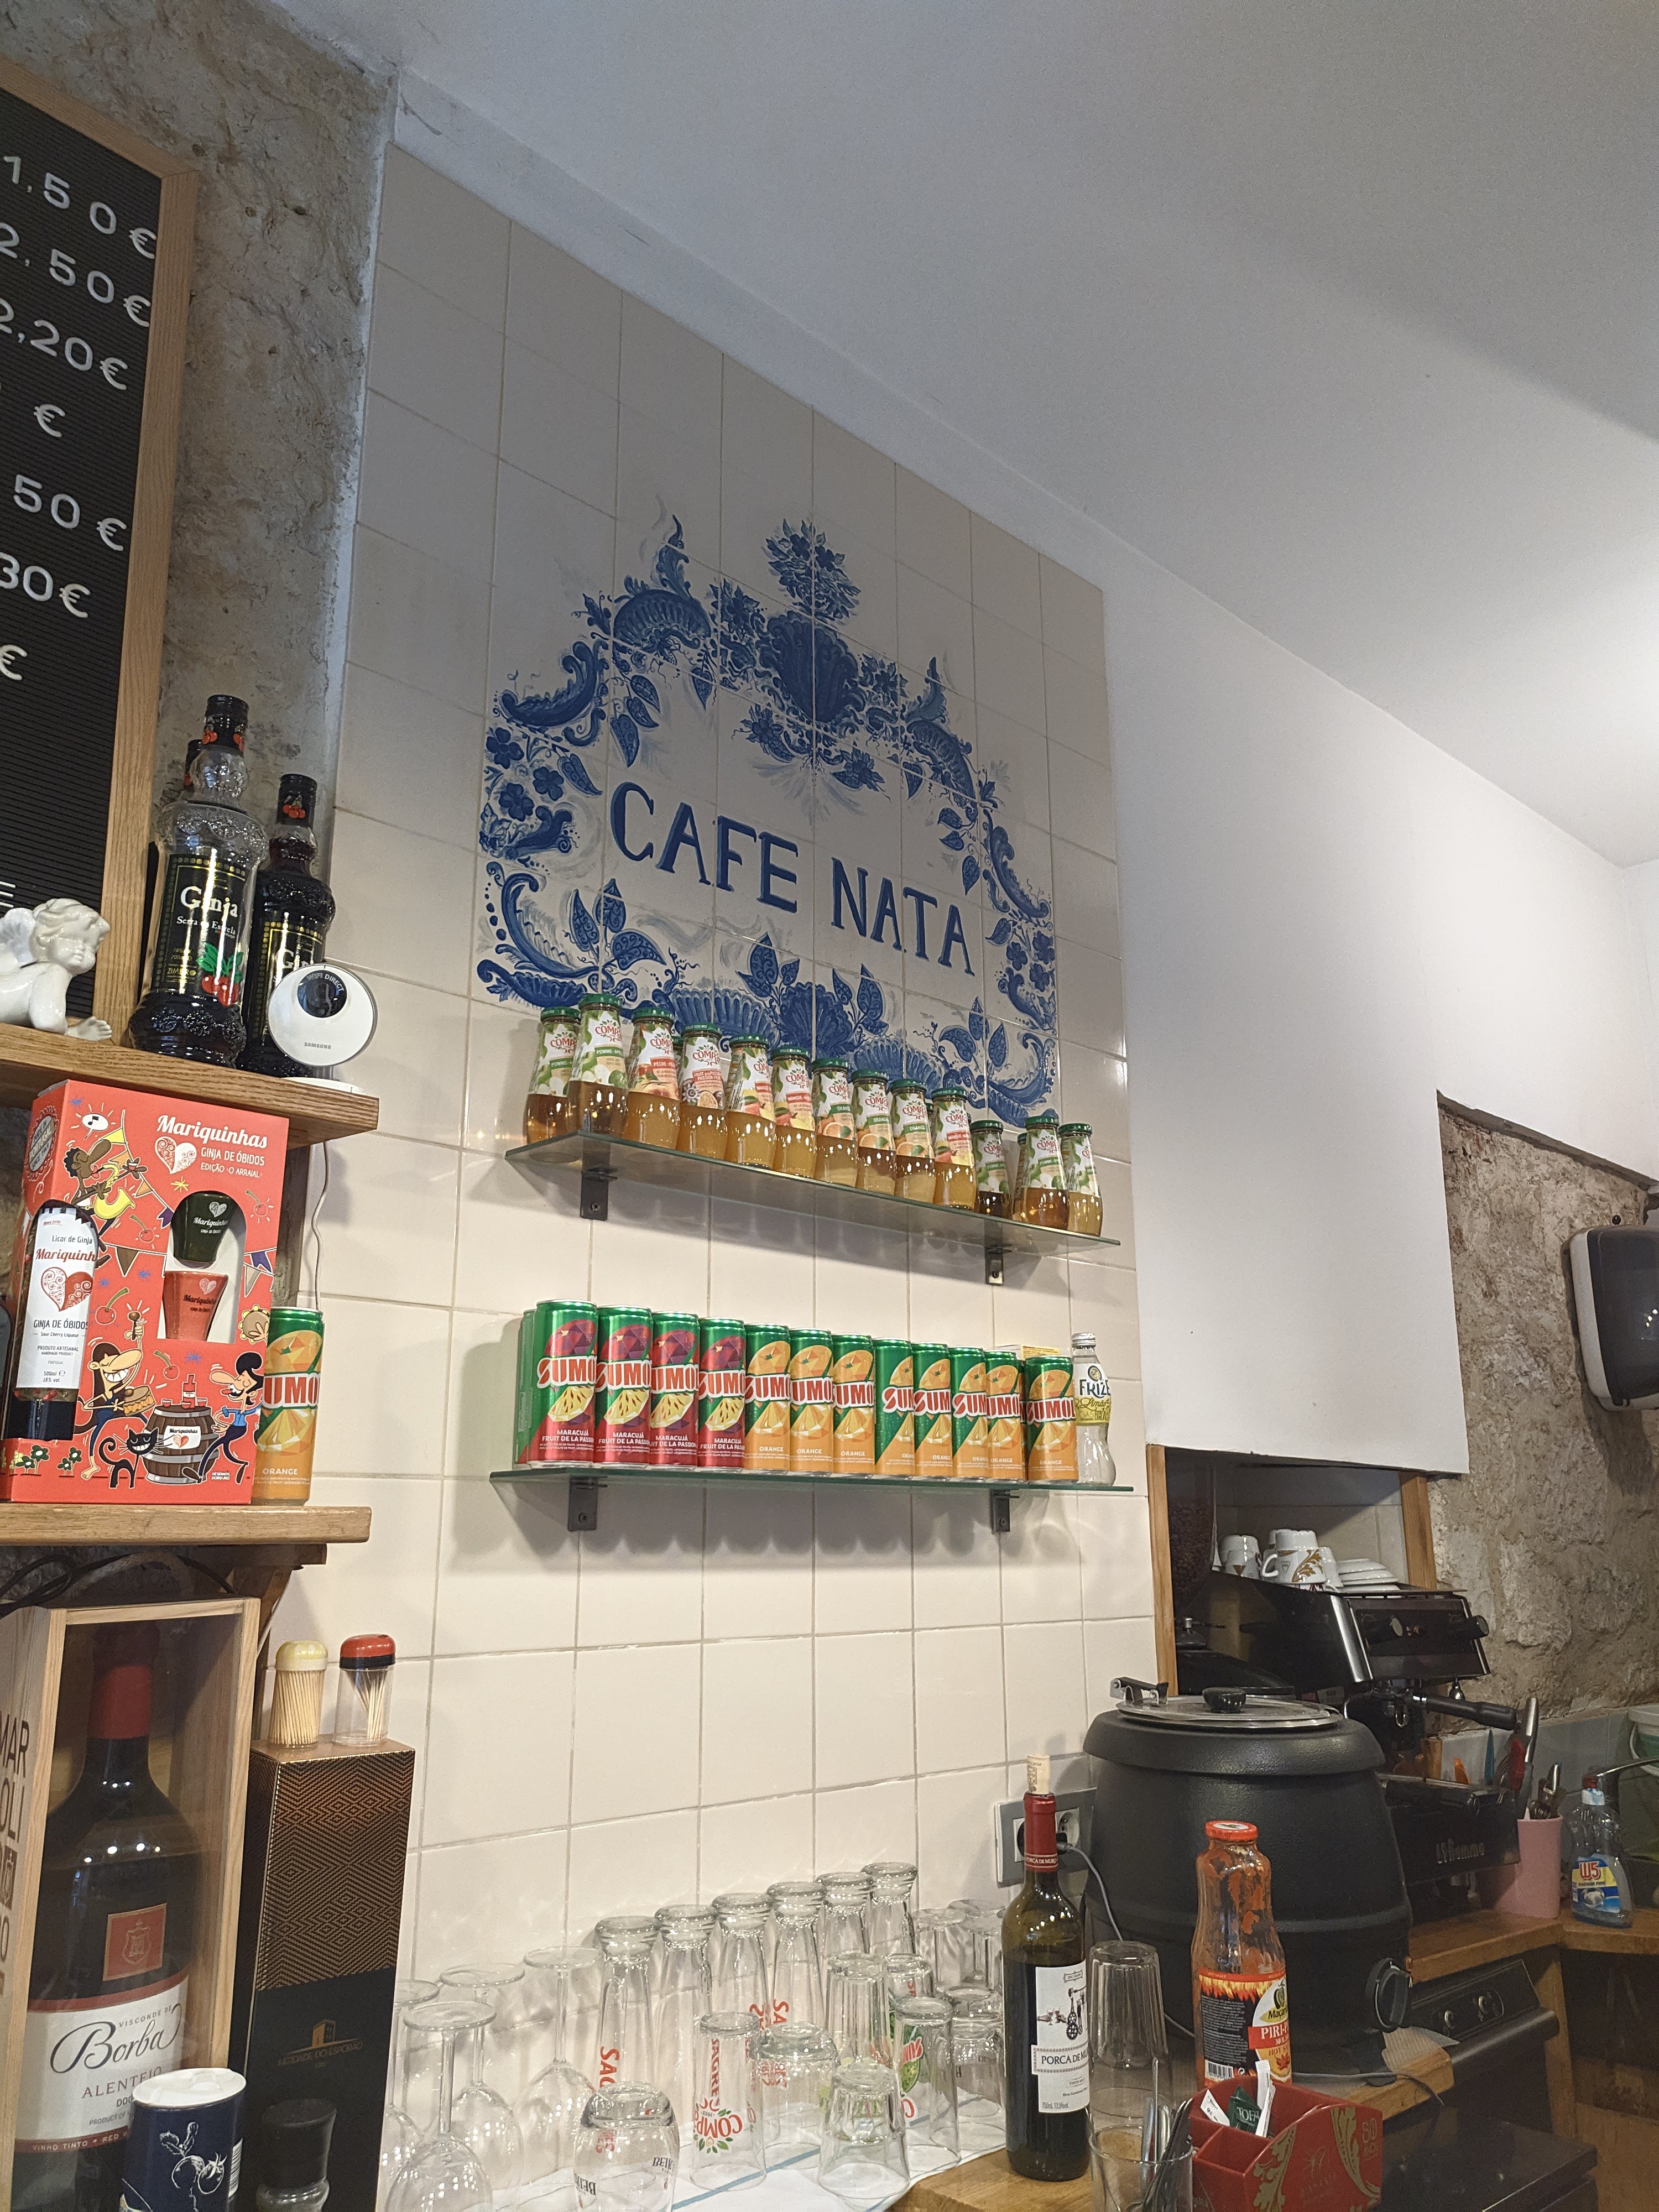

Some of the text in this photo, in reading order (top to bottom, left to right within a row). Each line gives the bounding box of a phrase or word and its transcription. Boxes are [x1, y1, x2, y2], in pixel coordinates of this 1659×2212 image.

[610, 781, 975, 977] CAFE NATA
[180, 885, 238, 918] Gnja
[212, 920, 236, 936] Esrela
[324, 973, 345, 992] DIRECT
[157, 1115, 268, 1149] Mariquinhas
[201, 1147, 265, 1166] GINJA DE ÓBIDOS
[201, 1162, 225, 1173] EDIÇÃO
[77, 1236, 93, 1245] Ginja
[34, 1319, 50, 1330] GINJA
[52, 1319, 62, 1328] DE
[1079, 1379, 1111, 1399] FRIZE
[263, 1468, 299, 1476] ORANGE
[119, 2010, 162, 2028] VISCONDE
[50, 2003, 182, 2074] Borba
[1041, 2052, 1072, 2065] PORCA
[1073, 2051, 1081, 2063] DE
[89, 2114, 118, 2126] PRODUCT
[63, 2141, 88, 2150] TINTO
[102, 2134, 119, 2143] RED
